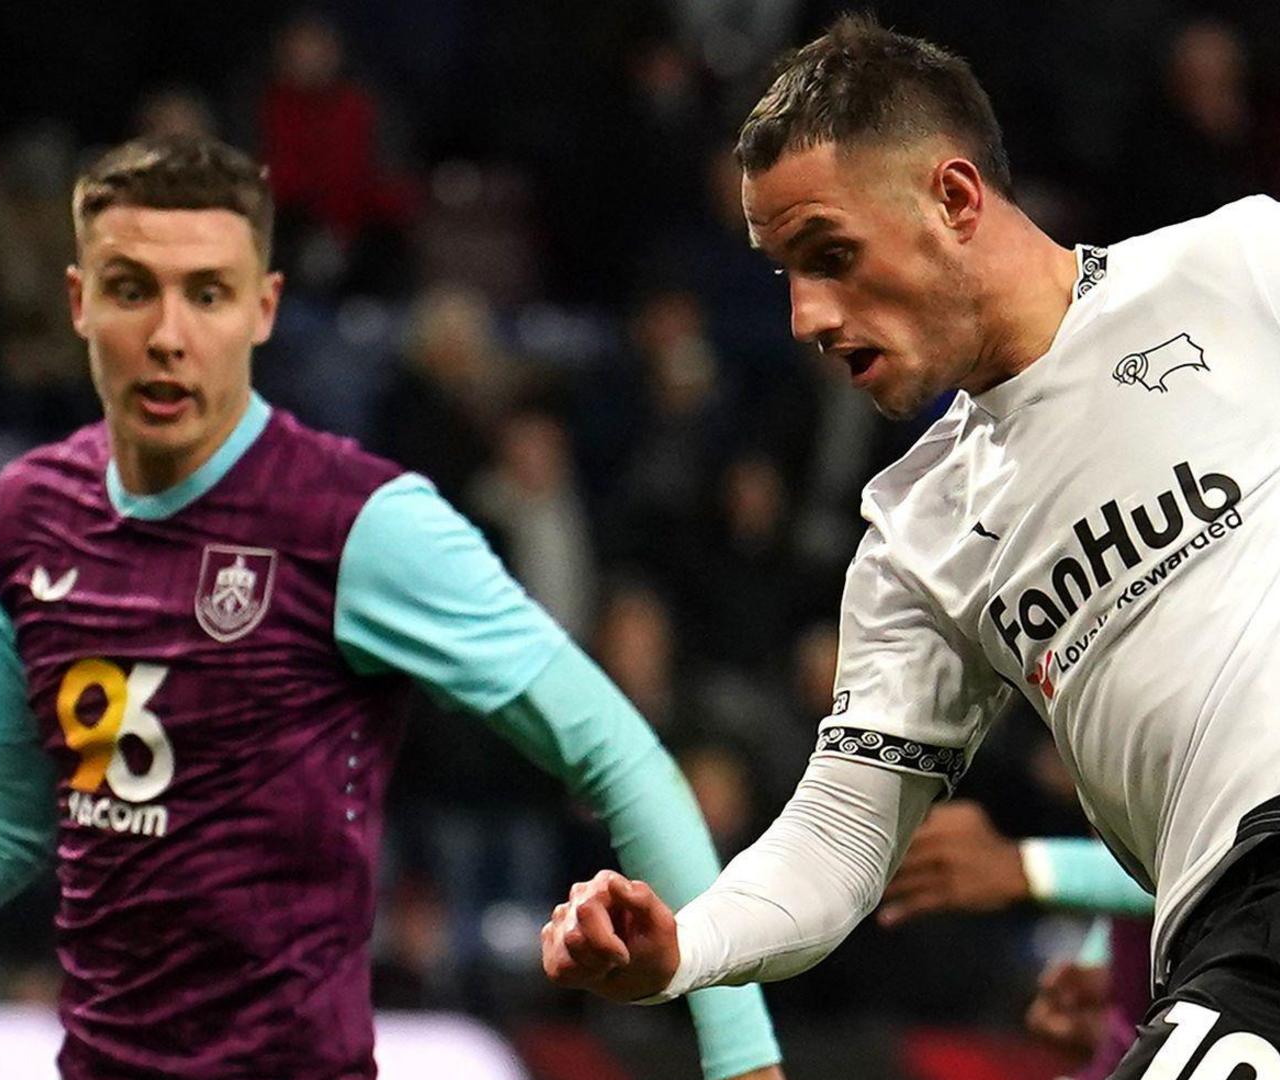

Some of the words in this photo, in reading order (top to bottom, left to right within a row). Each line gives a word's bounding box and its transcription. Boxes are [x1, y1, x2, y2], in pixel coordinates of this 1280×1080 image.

[988, 461, 1242, 668] FanHub
[1116, 507, 1243, 609] rewarded
[56, 658, 175, 803] 96
